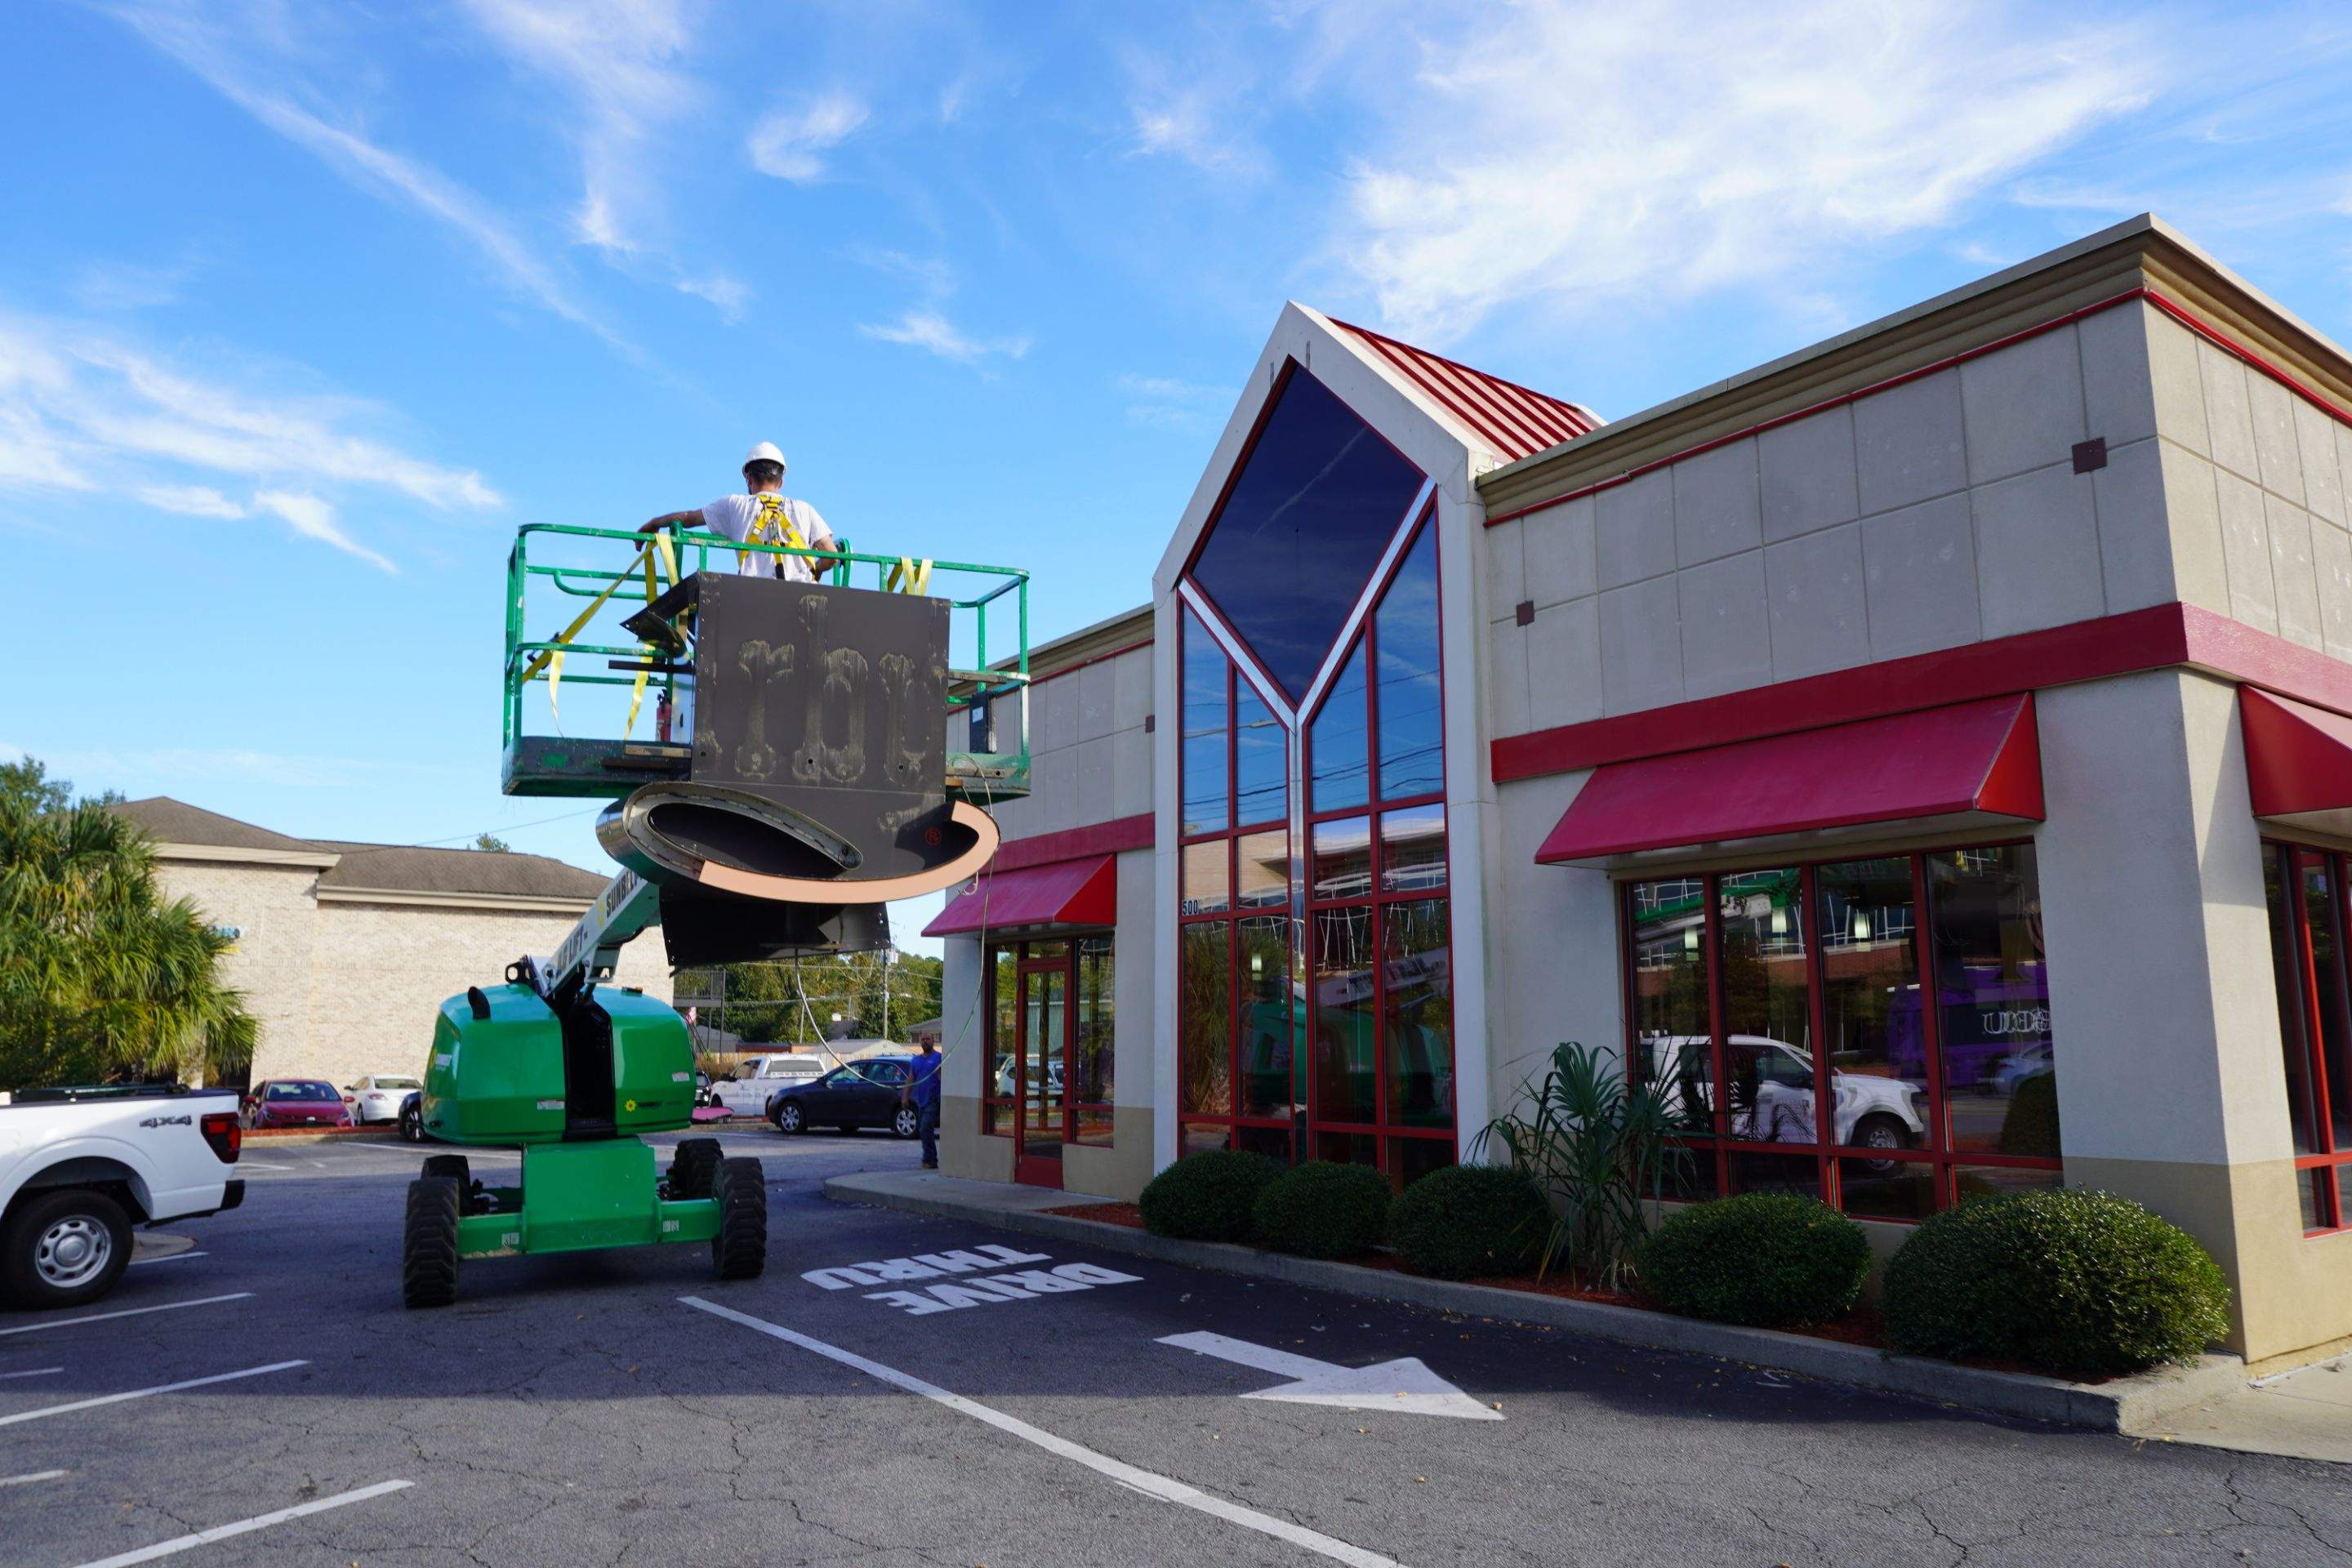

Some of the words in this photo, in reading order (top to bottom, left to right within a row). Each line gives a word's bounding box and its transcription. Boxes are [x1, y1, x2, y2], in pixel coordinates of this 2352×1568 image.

[1183, 900, 1198, 915] 500
[800, 1244, 1053, 1290] THRU
[861, 1263, 1145, 1316] DRIVE
